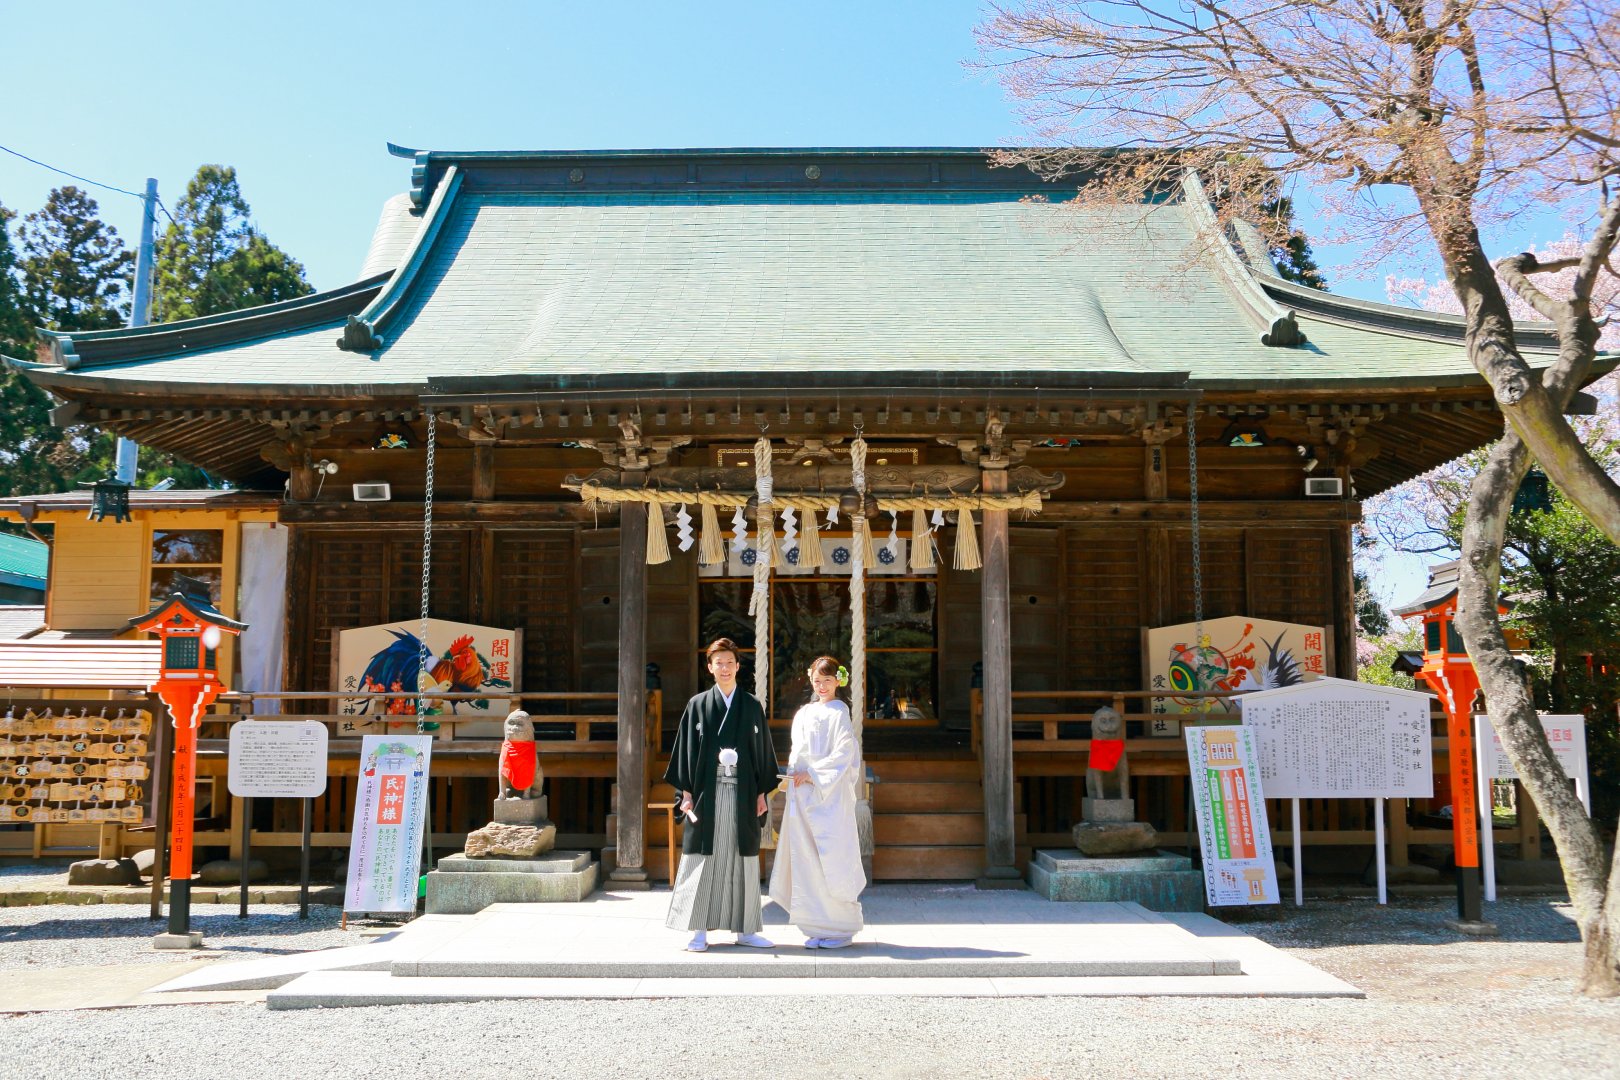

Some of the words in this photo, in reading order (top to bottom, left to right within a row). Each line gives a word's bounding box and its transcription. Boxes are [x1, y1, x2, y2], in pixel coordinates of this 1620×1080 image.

[490, 638, 510, 681] 開運
[1304, 631, 1324, 674] 開運
[1410, 720, 1422, 770] 愛宕神社
[175, 763, 186, 853] 平成九年二月二十四日
[381, 777, 400, 822] 氏神様
